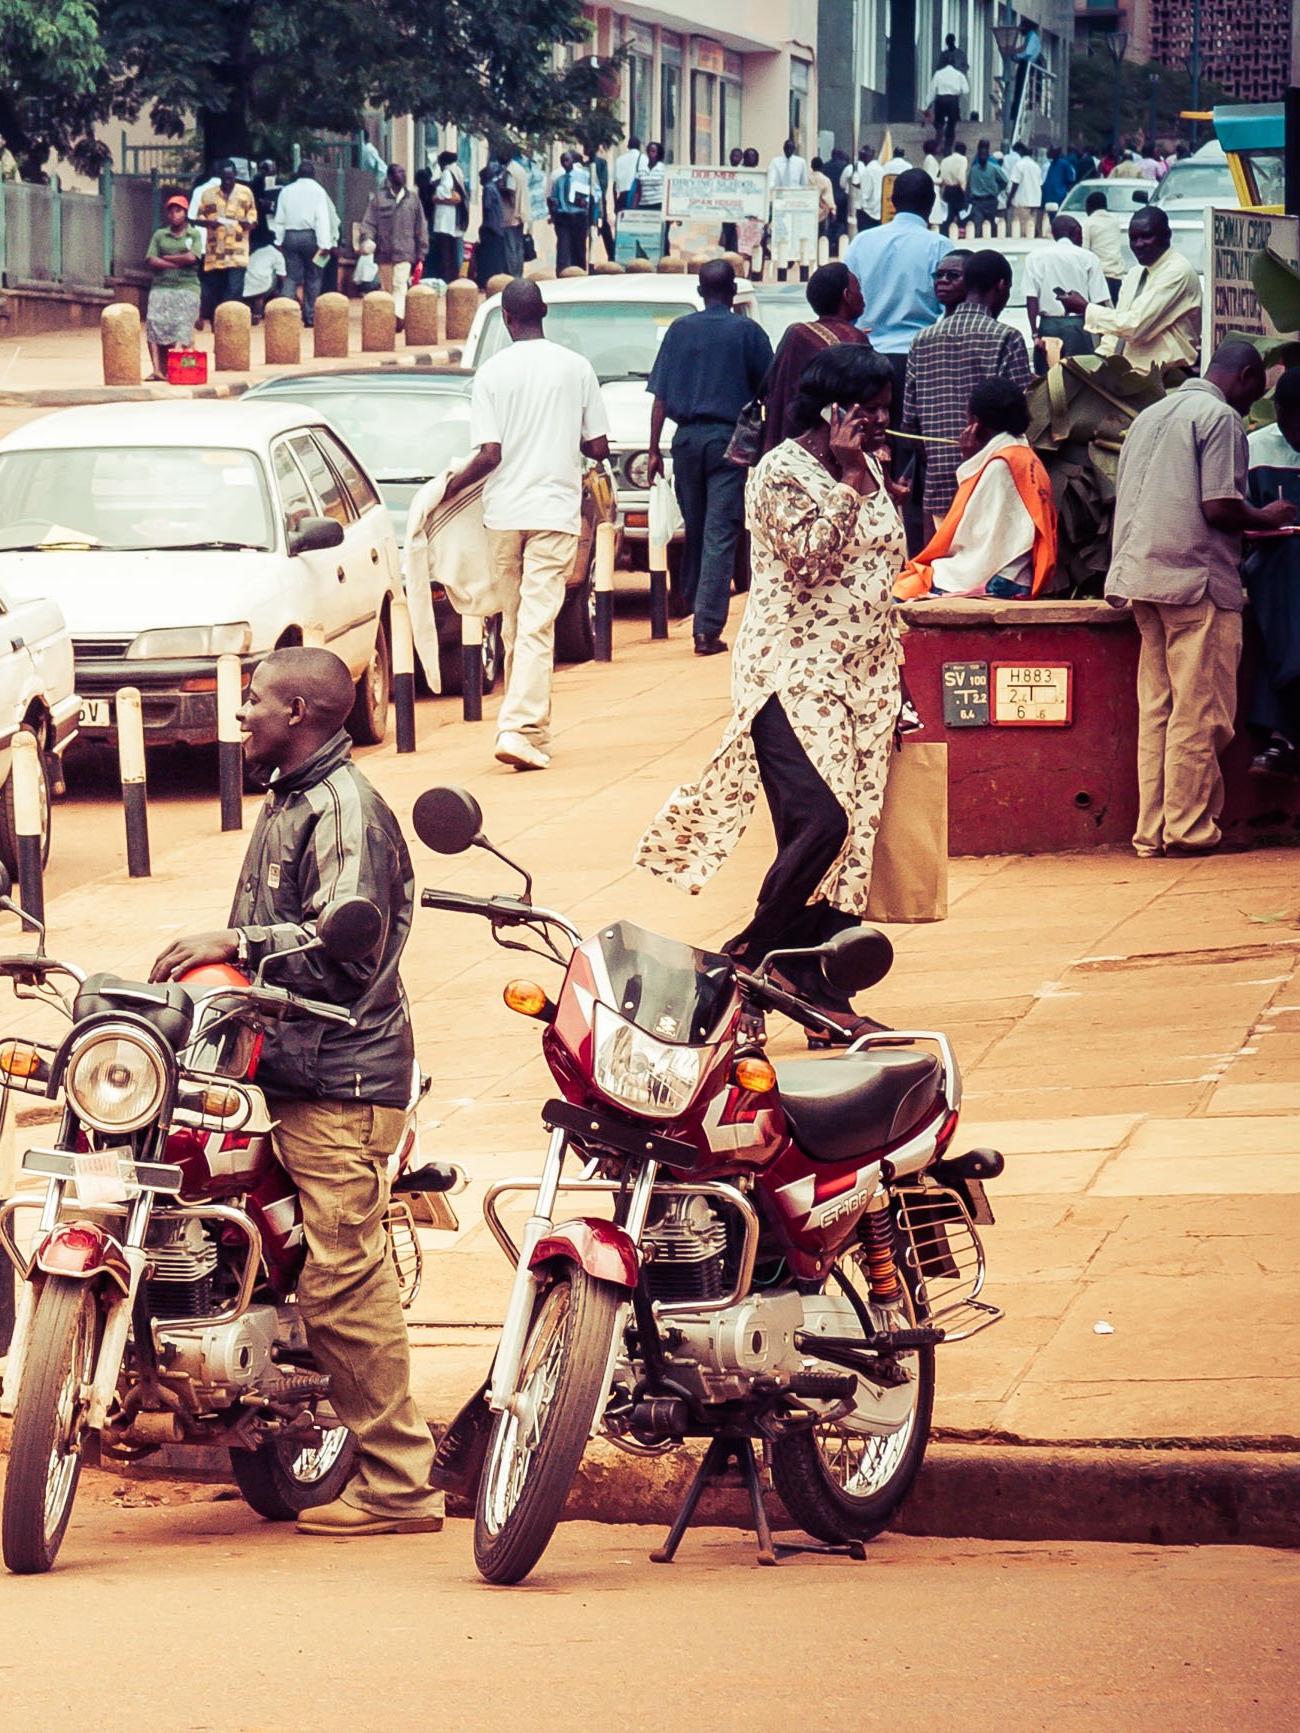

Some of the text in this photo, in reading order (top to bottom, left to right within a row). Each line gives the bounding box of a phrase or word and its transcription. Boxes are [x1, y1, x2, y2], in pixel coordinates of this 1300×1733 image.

[944, 671, 987, 687] SV 100
[1010, 668, 1052, 683] H883
